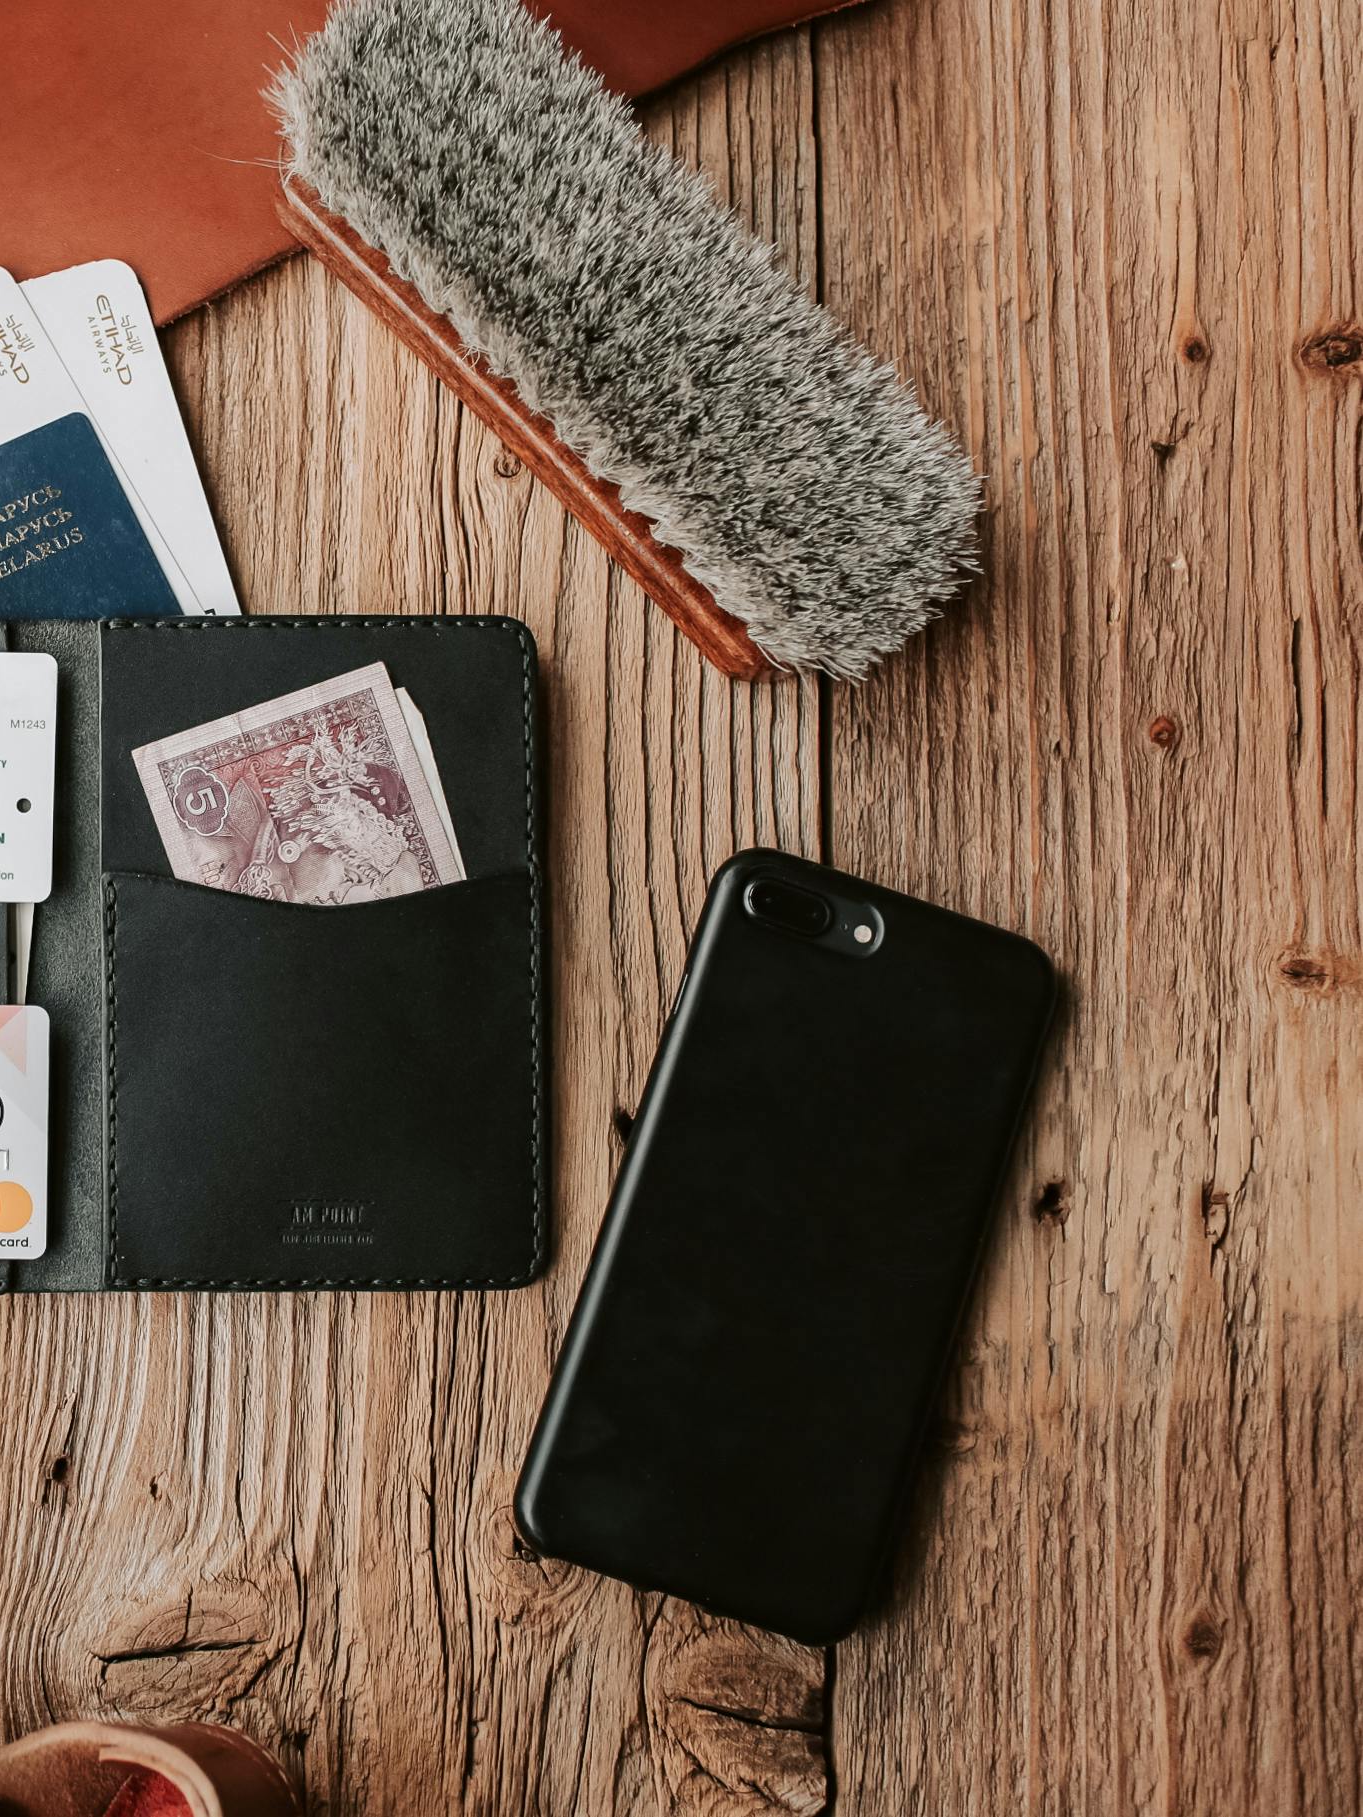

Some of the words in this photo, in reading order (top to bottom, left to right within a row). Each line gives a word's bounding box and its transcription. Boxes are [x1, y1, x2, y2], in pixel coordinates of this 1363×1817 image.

[87, 316, 112, 374] AIRWAYS
[96, 294, 132, 385] ETIHAD
[10, 719, 46, 730] M1243
[187, 787, 217, 816] 5
